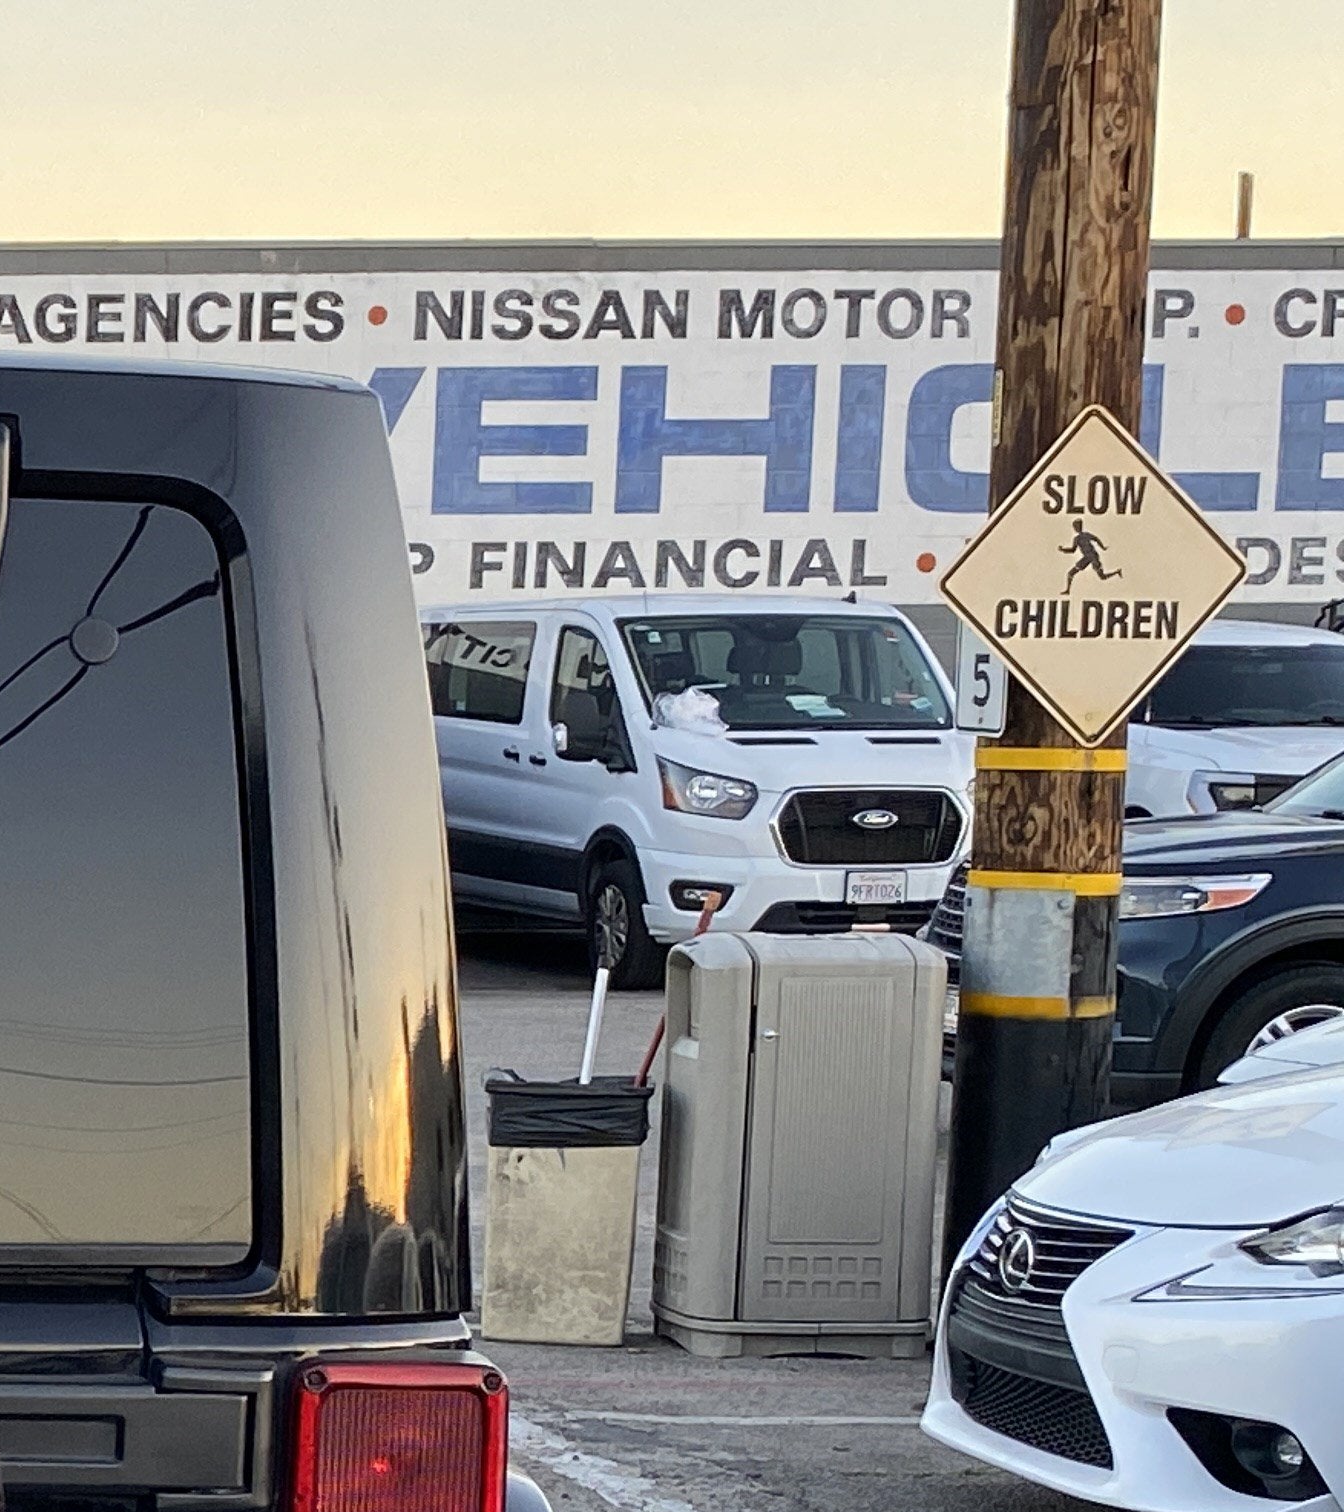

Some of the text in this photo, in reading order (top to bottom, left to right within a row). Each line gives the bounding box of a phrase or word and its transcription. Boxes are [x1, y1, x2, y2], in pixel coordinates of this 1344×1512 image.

[413, 288, 690, 341] NISSAN
[716, 287, 972, 340] MOTOR
[1041, 474, 1148, 516] SLOW
[468, 537, 888, 590] FINANCIAL
[994, 598, 1180, 641] CHILDREN
